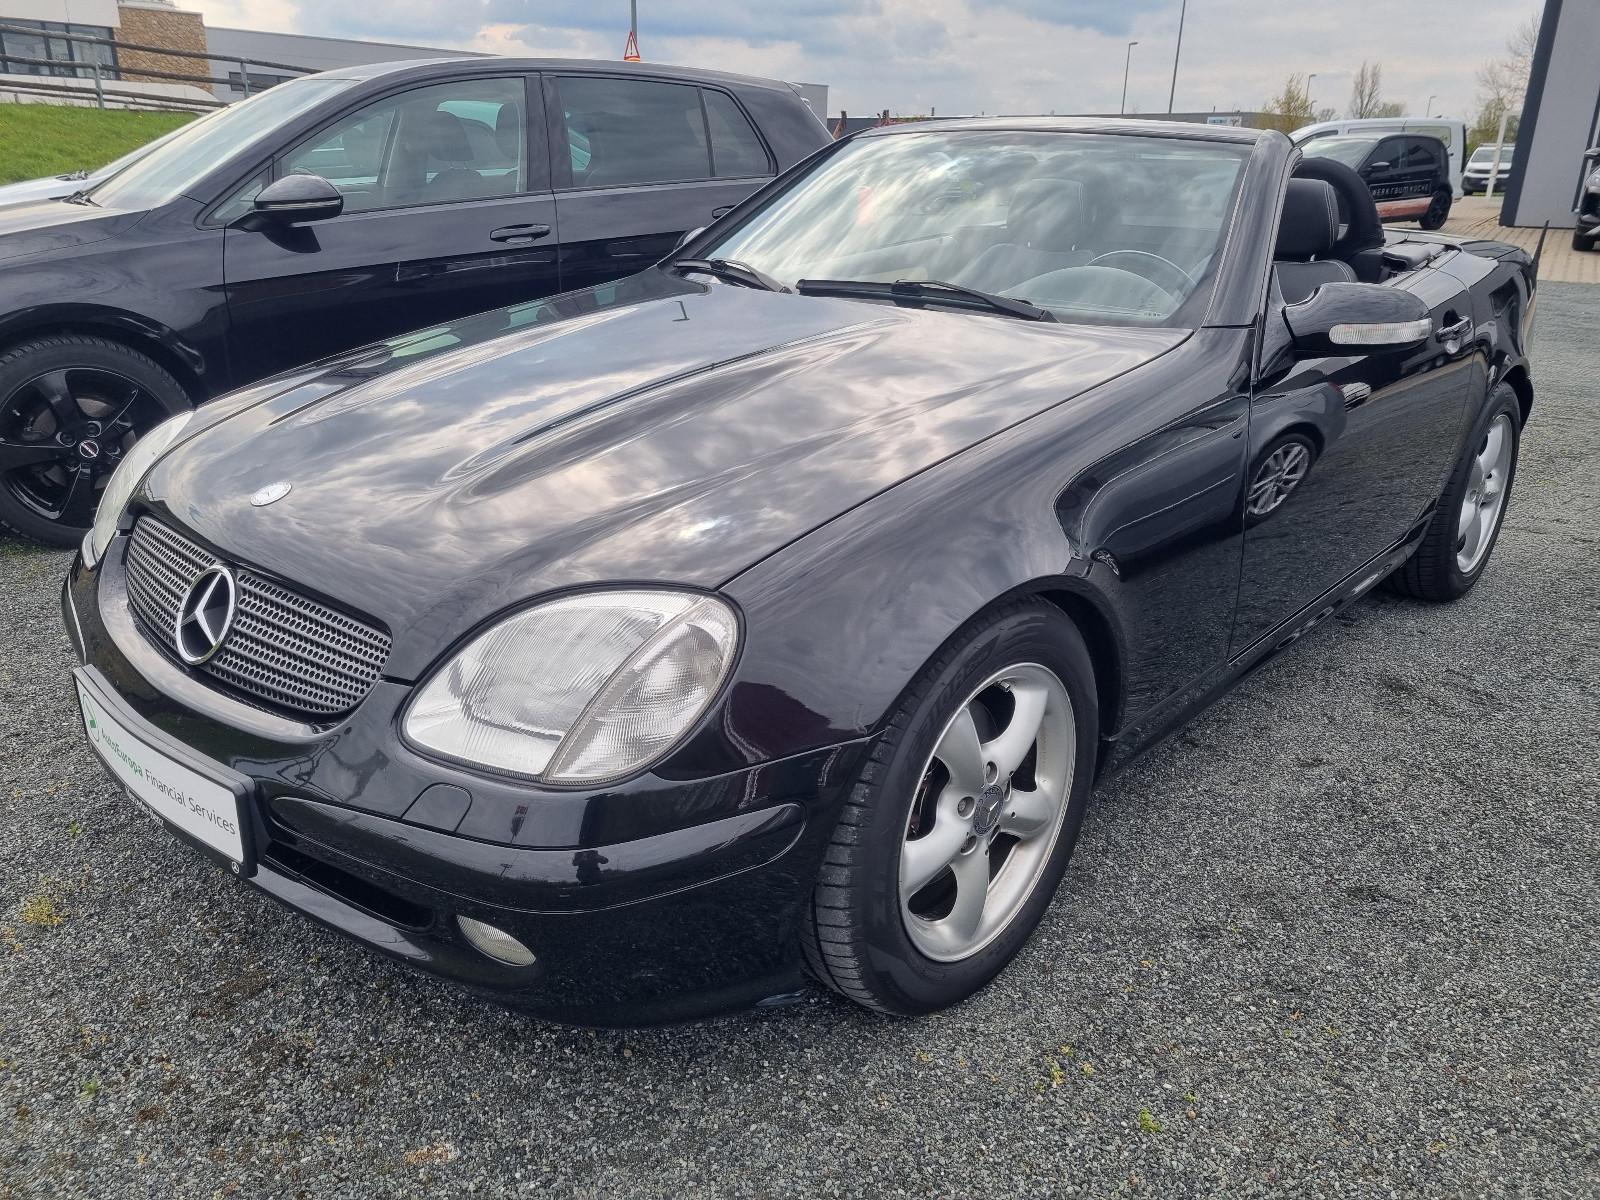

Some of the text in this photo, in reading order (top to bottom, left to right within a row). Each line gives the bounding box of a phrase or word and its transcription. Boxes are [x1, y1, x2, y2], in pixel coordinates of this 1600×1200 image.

[101, 728, 144, 777] AutoEuropa
[145, 768, 186, 807] Financial
[188, 797, 236, 835] Services
